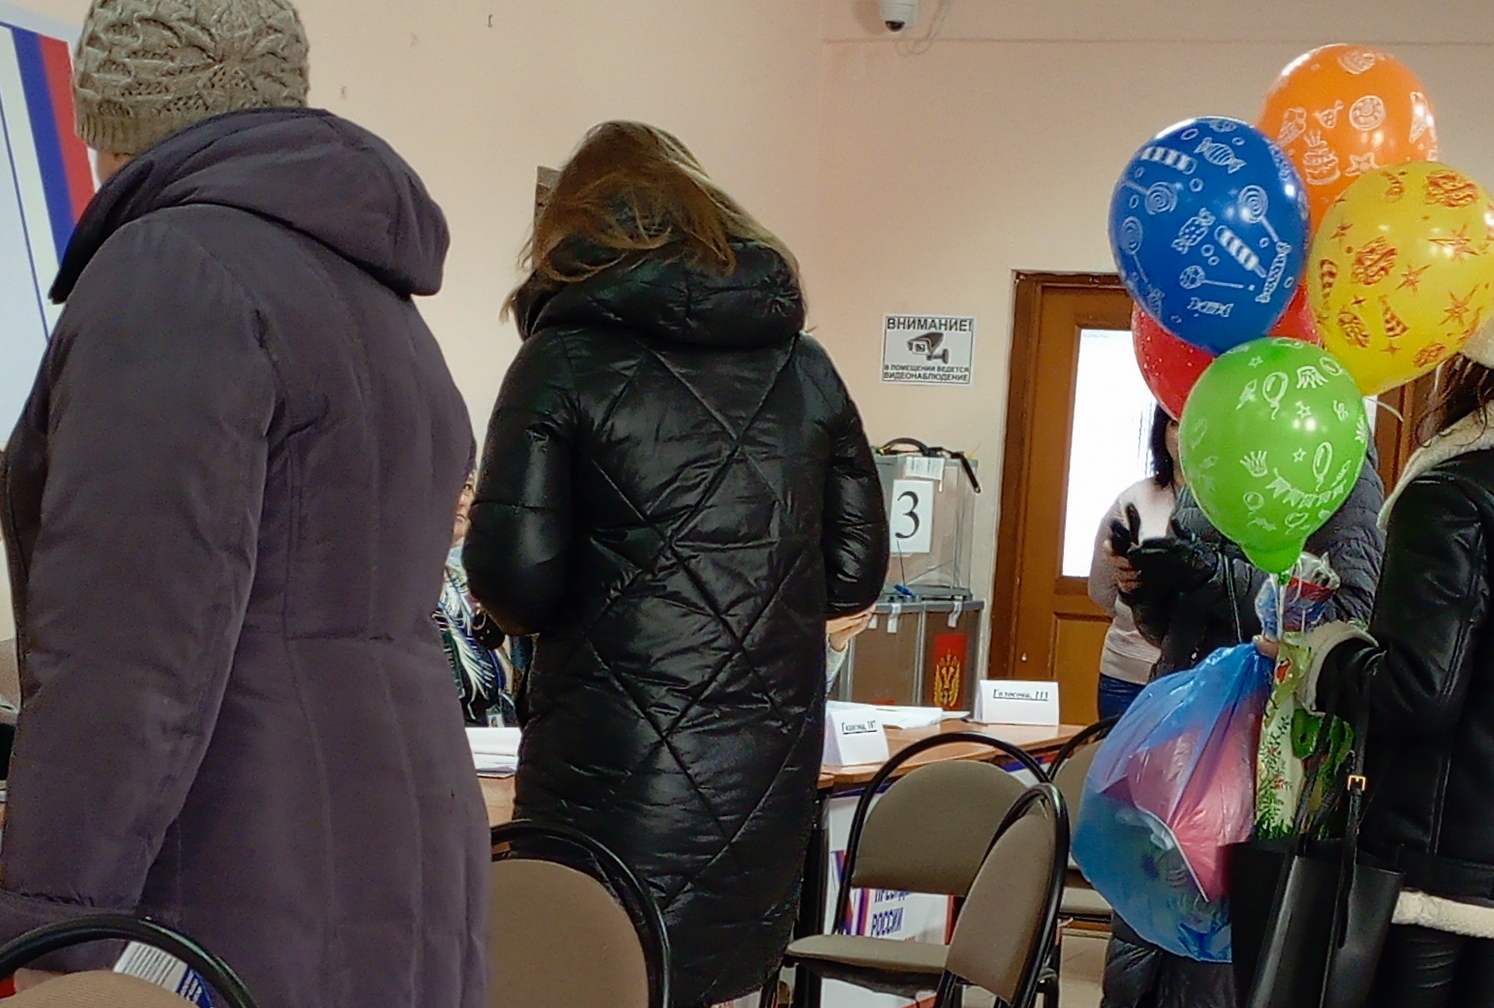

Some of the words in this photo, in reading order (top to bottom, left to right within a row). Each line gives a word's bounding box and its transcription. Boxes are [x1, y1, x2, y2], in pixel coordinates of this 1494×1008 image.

[887, 317, 972, 331] ВНИМАНИЕ!
[884, 372, 969, 381] ВИДЕОНАБЛЮДЕНИЕ
[895, 491, 919, 538] 3
[871, 907, 904, 937] РОССИИ
